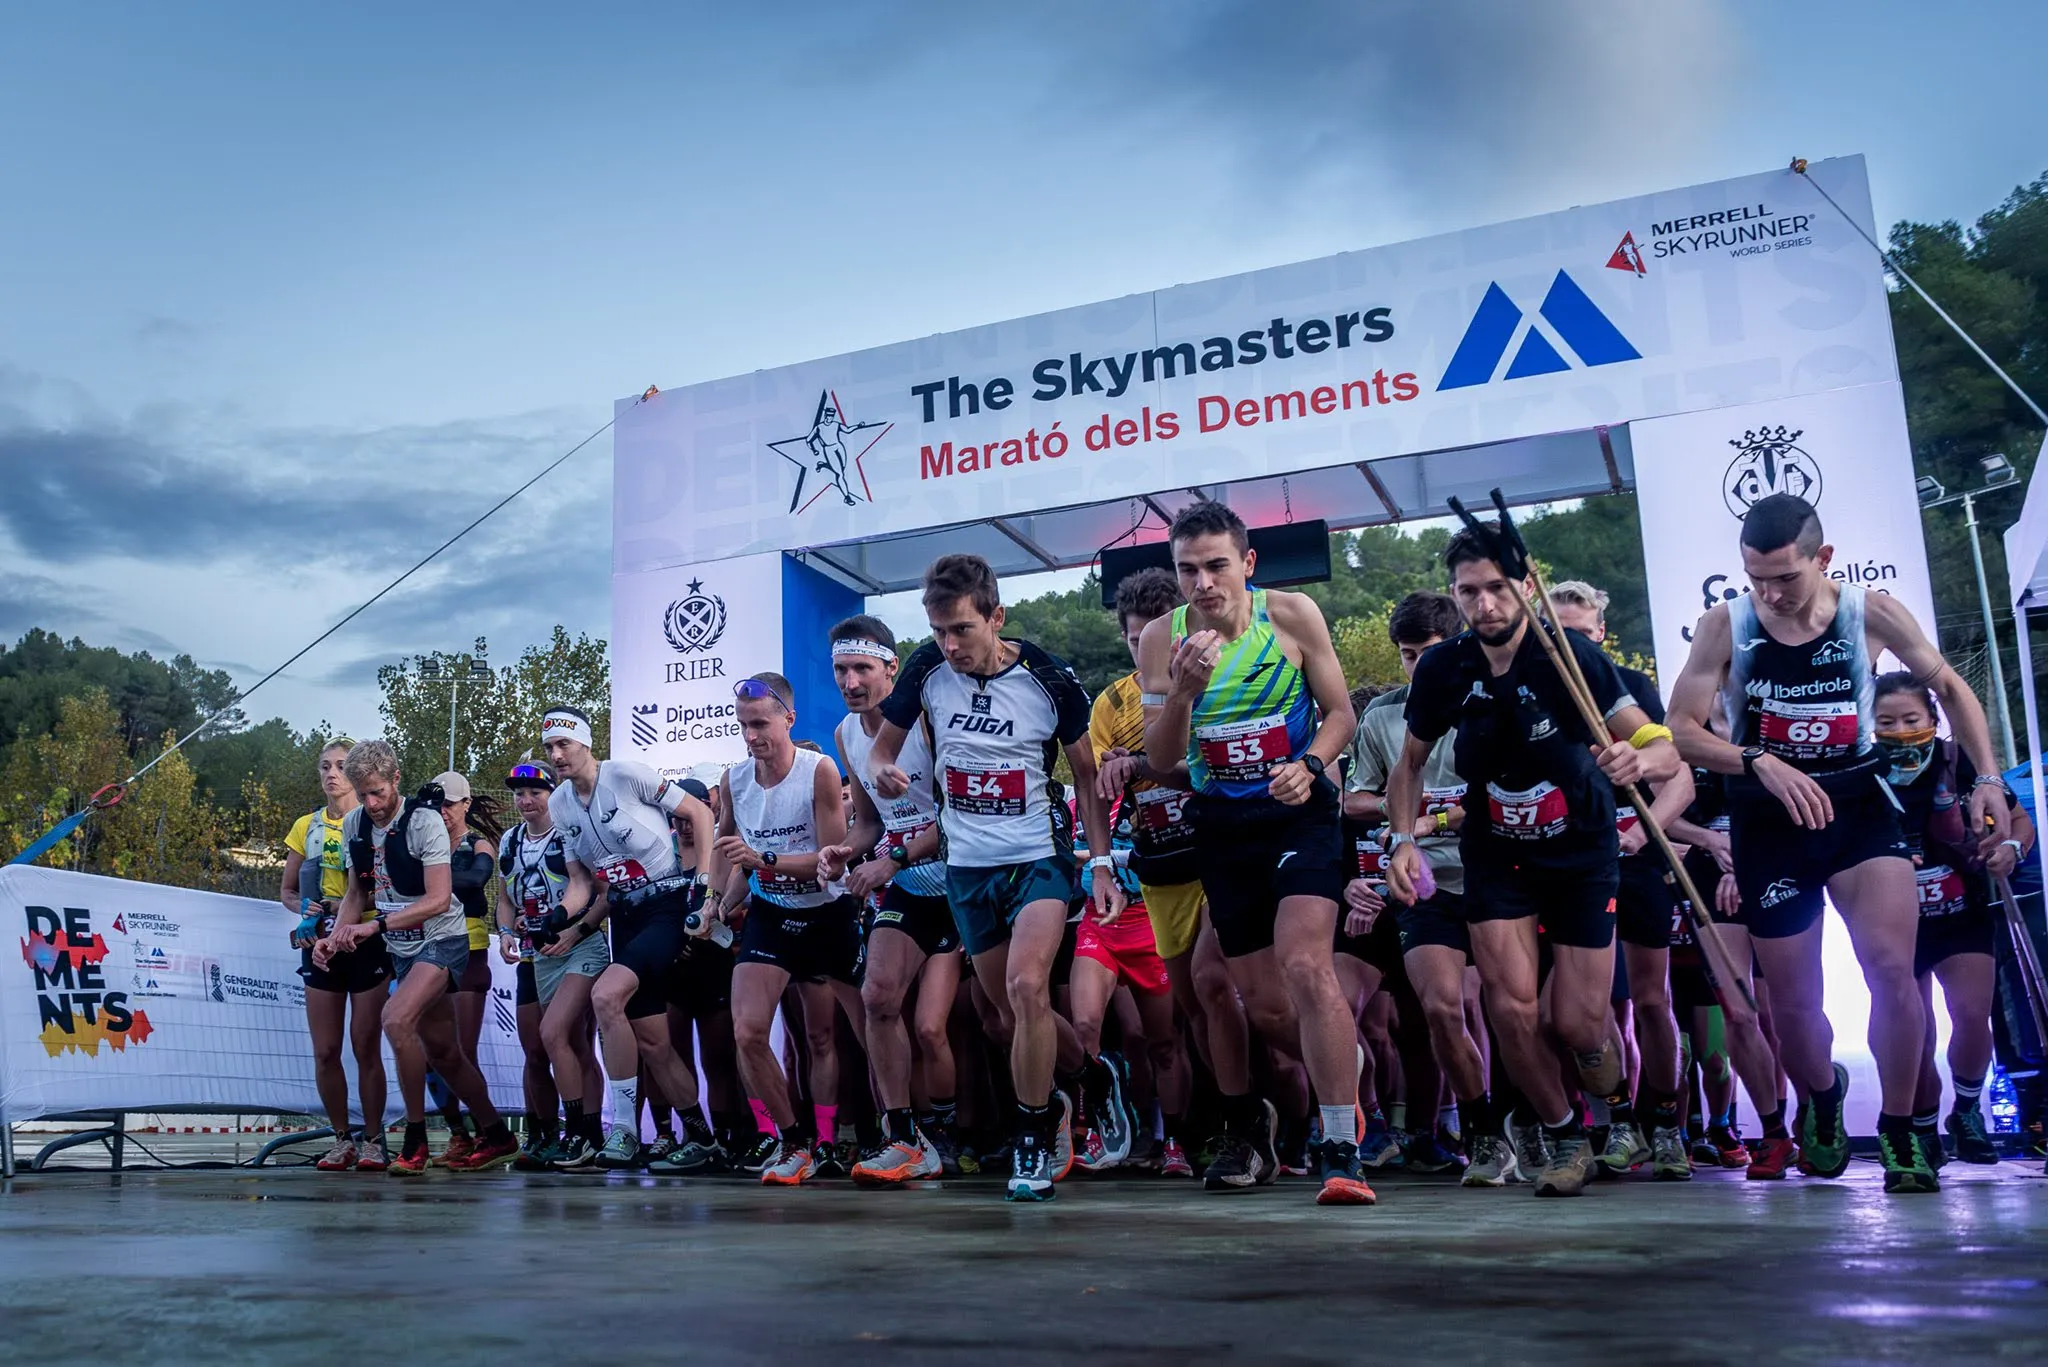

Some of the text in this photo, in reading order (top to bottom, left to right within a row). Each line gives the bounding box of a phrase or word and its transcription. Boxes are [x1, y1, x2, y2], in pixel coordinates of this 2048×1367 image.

[1651, 204, 1773, 237] MERRELL
[1730, 236, 1812, 258] WORLD SERIES
[911, 306, 1395, 423] The Skymasters
[920, 368, 1420, 480] Marató dels Dements
[664, 657, 726, 683] IRIER
[1774, 677, 1851, 699] Iberdrola
[666, 723, 690, 743] de
[947, 713, 1014, 736] FUGA
[1787, 721, 1830, 742] 69
[1227, 738, 1263, 763] 53
[966, 775, 1003, 797] 54
[1502, 805, 1538, 825] 57
[754, 823, 807, 838] SCARPA
[606, 865, 630, 883] 52
[25, 906, 95, 948] DE
[127, 912, 168, 922] MERRELL
[34, 949, 106, 990] ME
[223, 974, 279, 991] GENERALITAT
[225, 986, 280, 1001] VALENCIANA
[37, 992, 133, 1034] NTS
